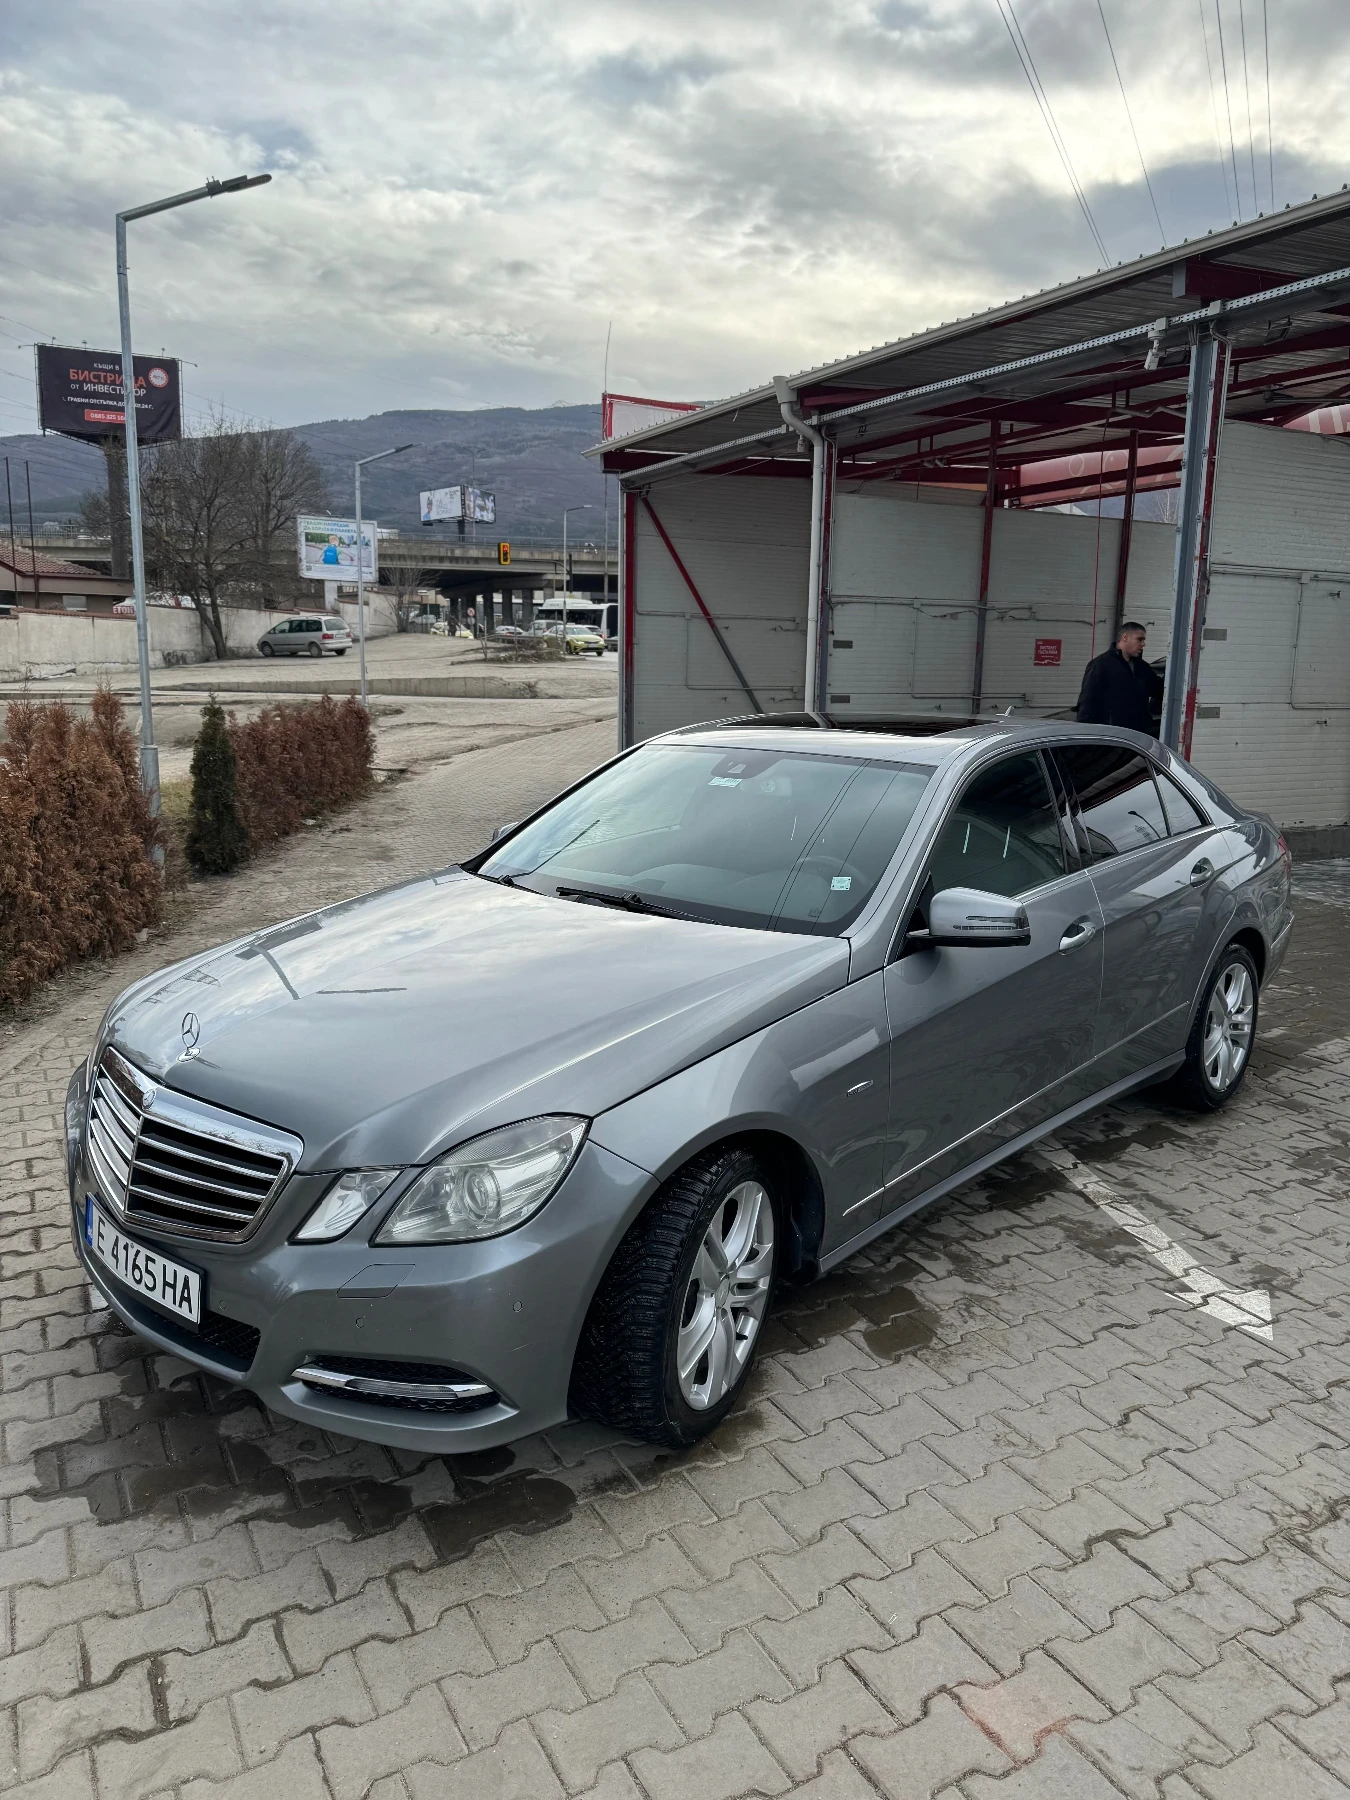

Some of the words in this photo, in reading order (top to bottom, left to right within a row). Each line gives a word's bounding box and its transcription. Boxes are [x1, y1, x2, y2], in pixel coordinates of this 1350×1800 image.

[83, 382, 146, 396] ИНВЕСТИОР
[97, 1216, 106, 1256] E
[111, 1235, 157, 1292] 4165
